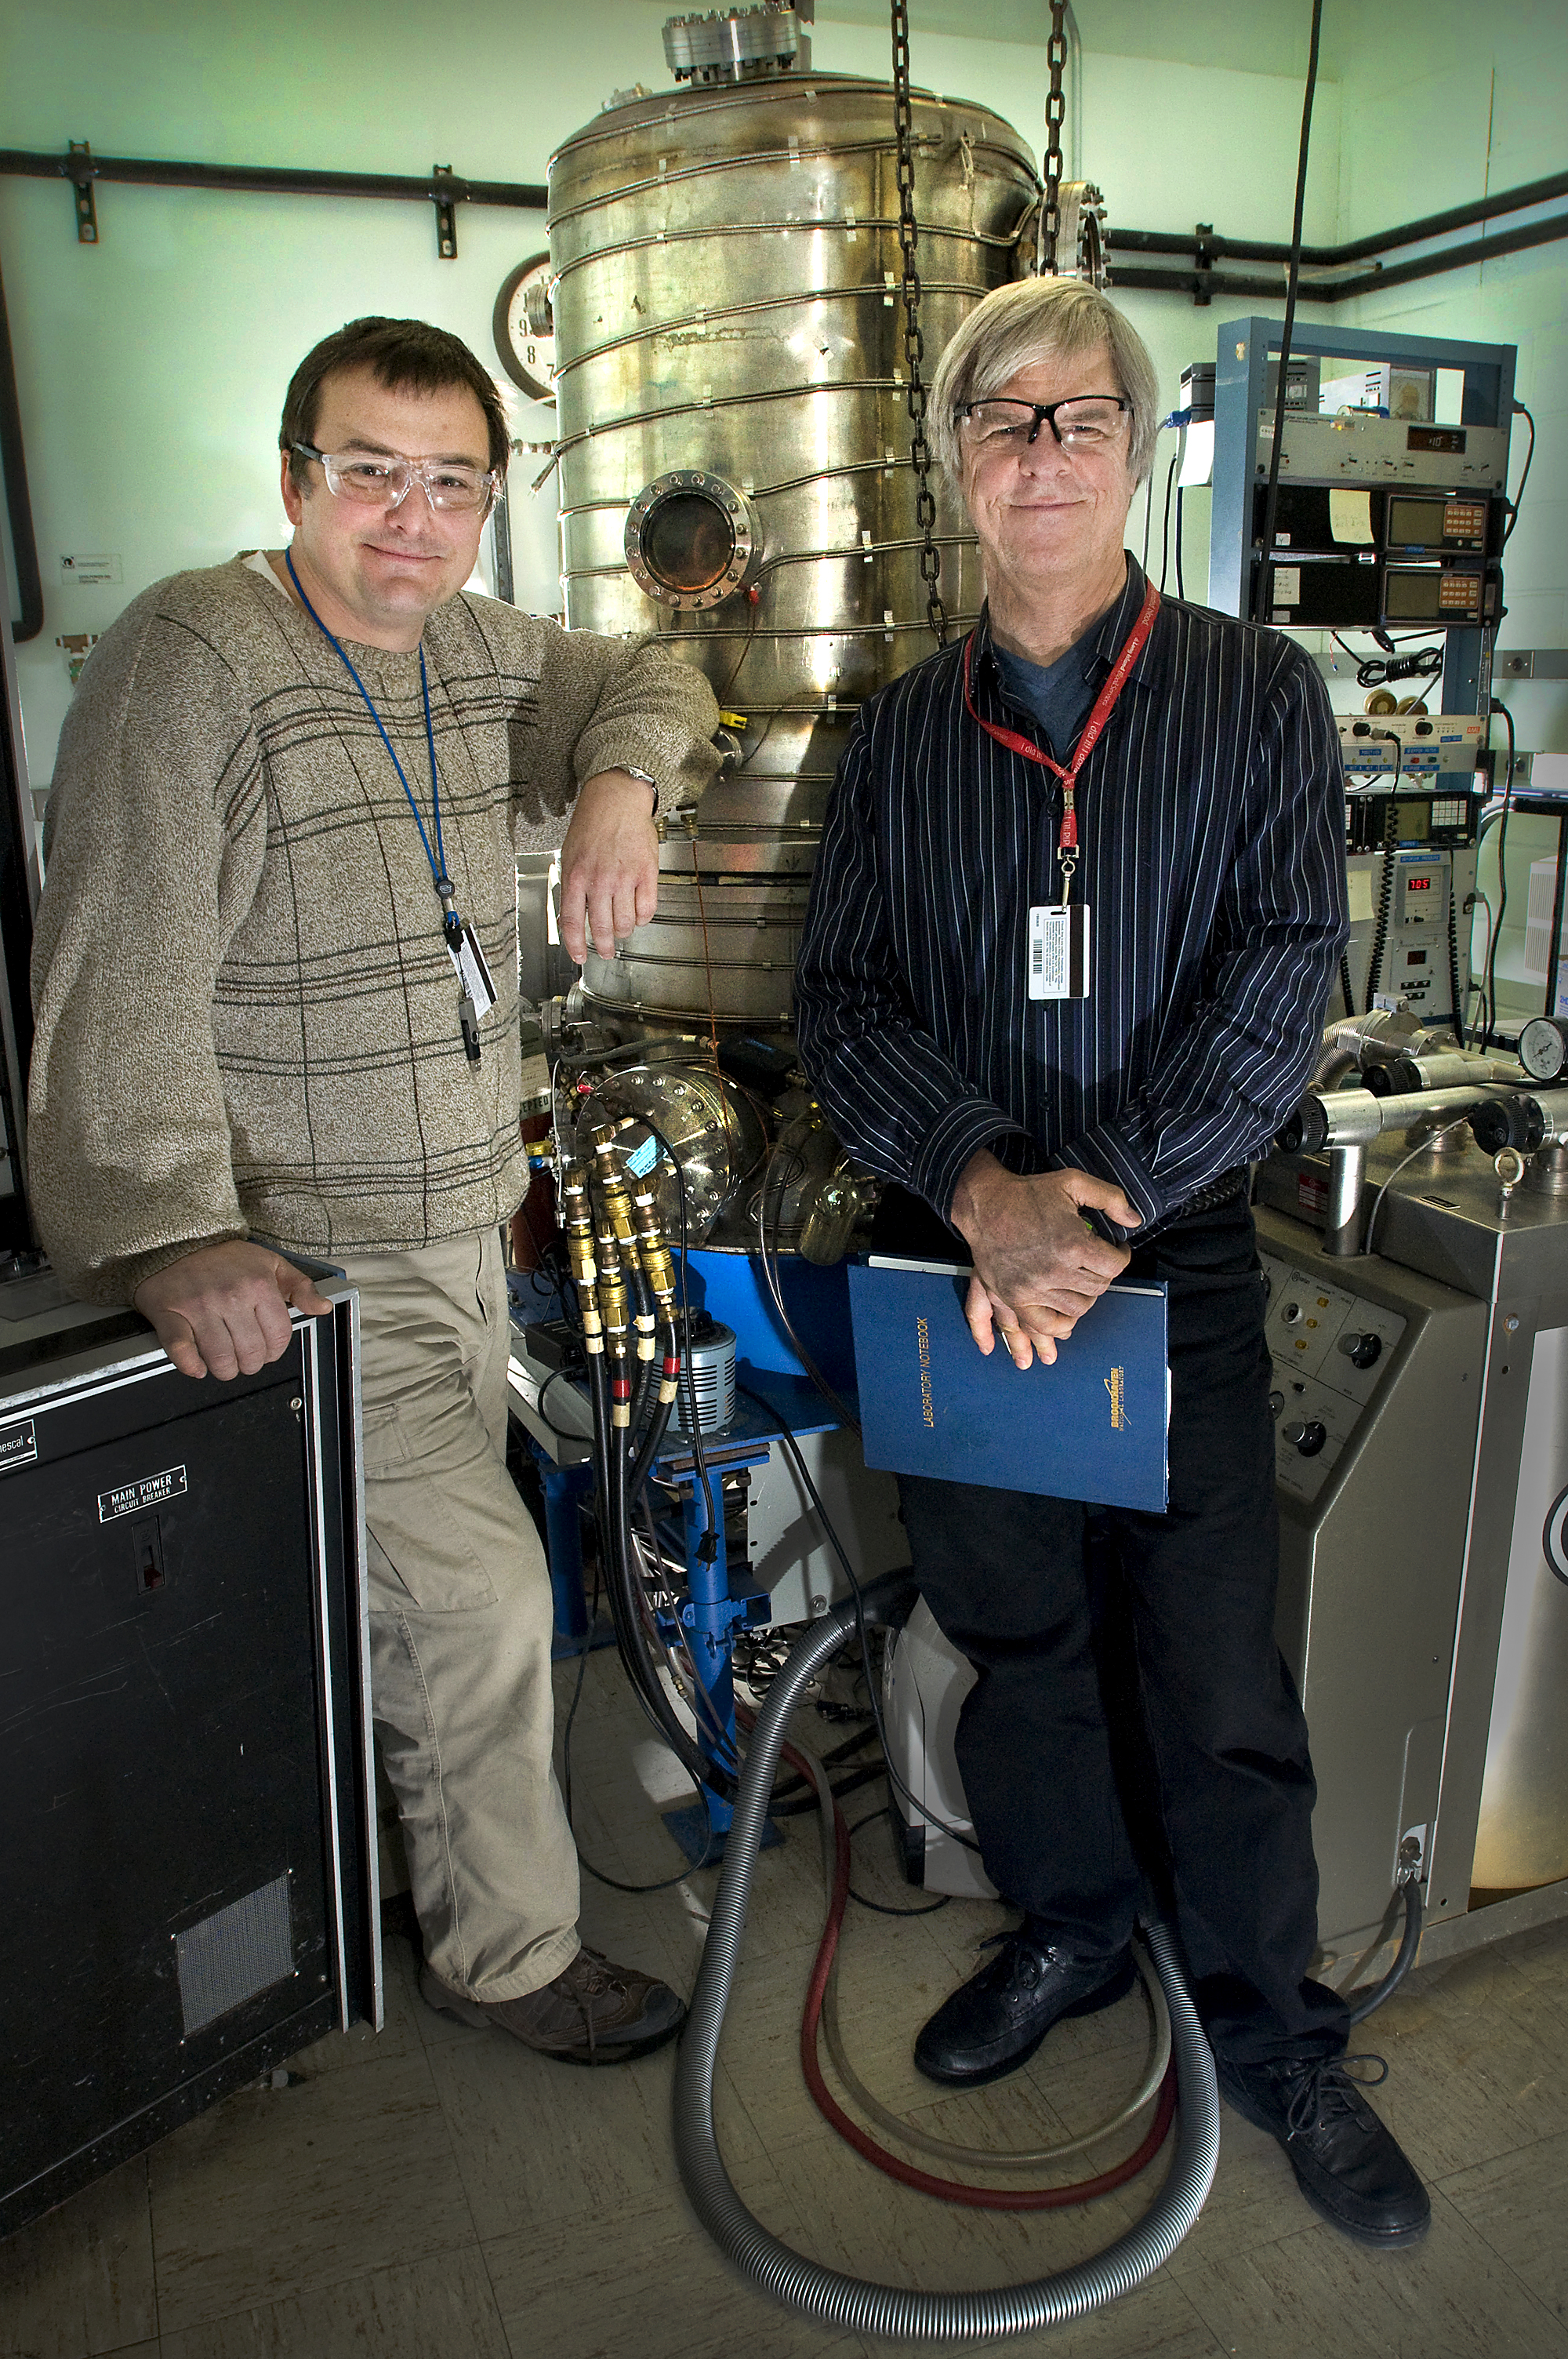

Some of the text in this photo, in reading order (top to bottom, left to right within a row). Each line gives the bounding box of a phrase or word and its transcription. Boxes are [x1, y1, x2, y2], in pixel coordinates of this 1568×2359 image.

[519, 319, 528, 337] 9
[527, 345, 536, 365] 8
[546, 364, 555, 380] 7
[1120, 653, 1132, 671] Island
[1112, 670, 1124, 686] Blood
[1087, 726, 1097, 740] did
[1073, 753, 1085, 774] dona
[519, 1096, 548, 1114] EPTED
[916, 1317, 934, 1427] LABORATORY NOTEBOOK
[1110, 1367, 1119, 1428] BROOKHAVEN
[111, 1474, 172, 1506] MAIN POWER
[114, 1486, 171, 1514] CIRCUIT BREAKER
